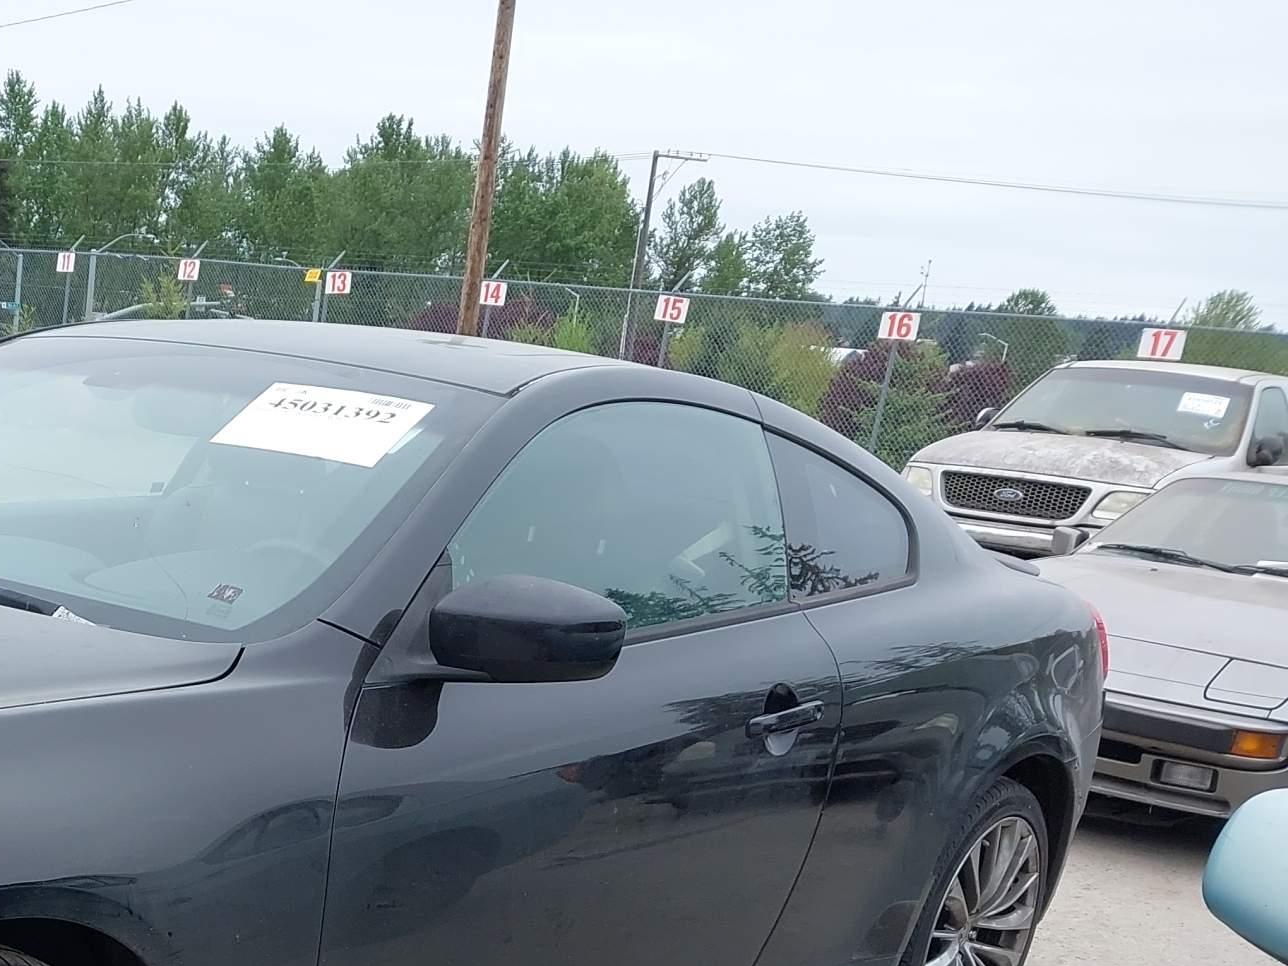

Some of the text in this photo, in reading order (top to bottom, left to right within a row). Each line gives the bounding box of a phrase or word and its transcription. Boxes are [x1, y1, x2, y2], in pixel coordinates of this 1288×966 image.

[62, 253, 72, 269] 11
[182, 260, 196, 279] 12
[331, 273, 347, 292] 13
[483, 282, 502, 304] 14
[662, 296, 685, 321] 15
[887, 313, 915, 339] 16
[1150, 330, 1178, 357] 17
[268, 397, 397, 424] 45031392
